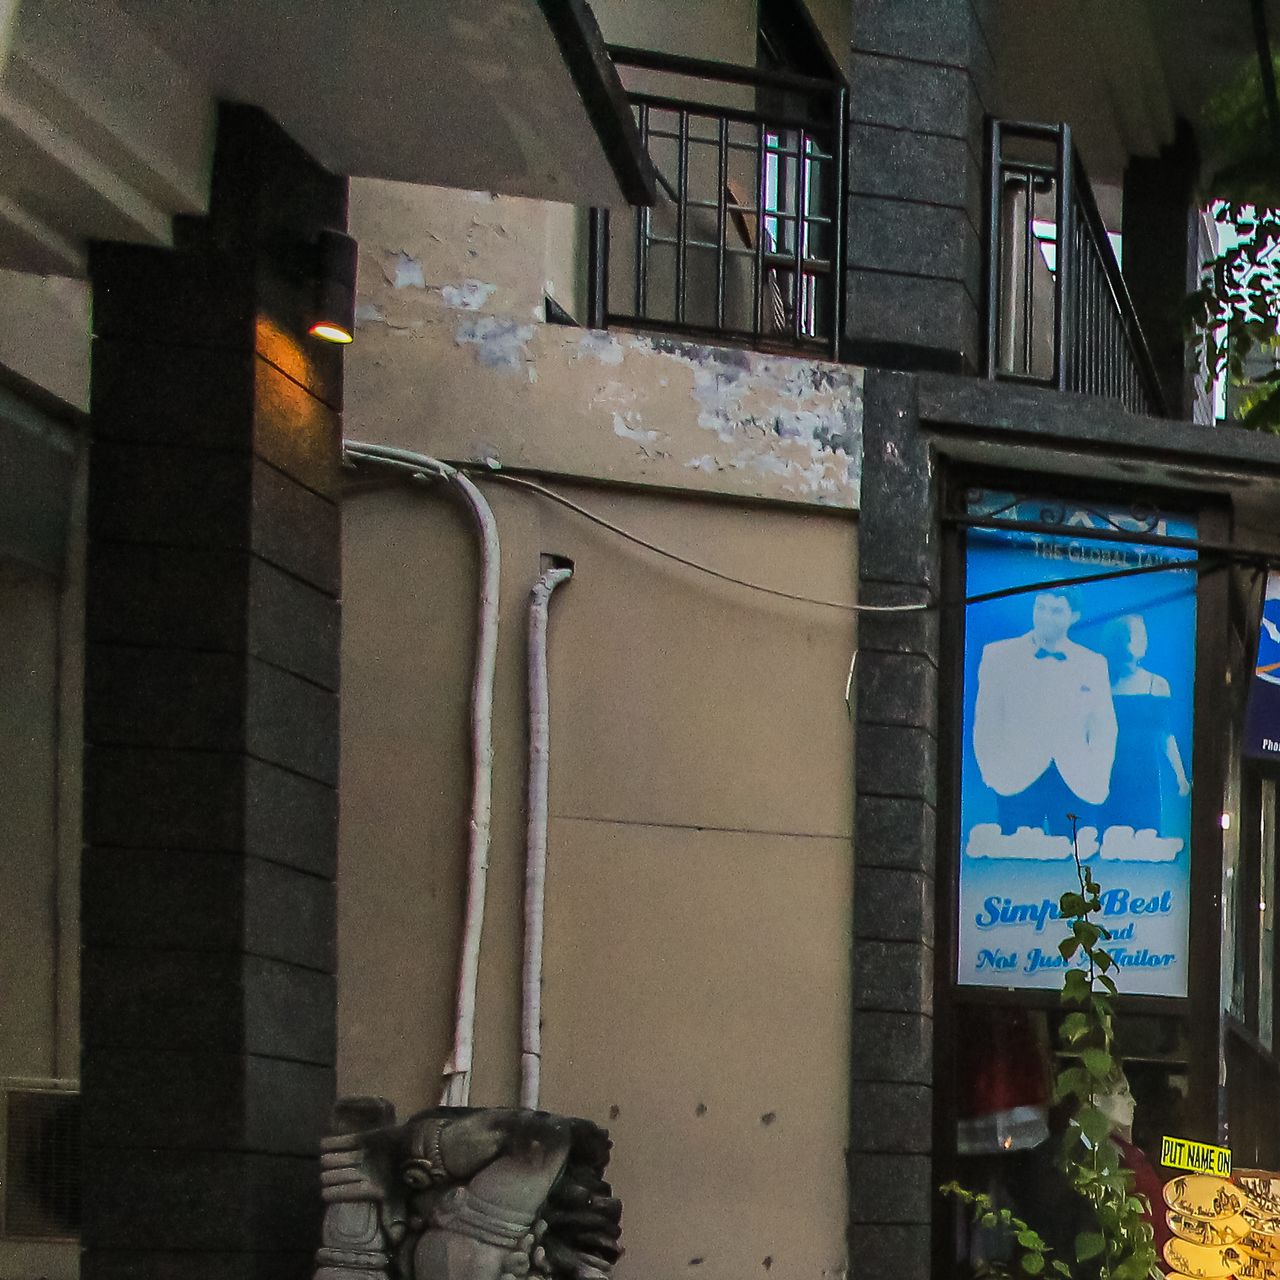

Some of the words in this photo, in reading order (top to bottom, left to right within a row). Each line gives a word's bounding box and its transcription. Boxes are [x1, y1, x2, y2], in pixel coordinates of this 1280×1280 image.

[975, 896, 1076, 932] Simp
[1101, 888, 1173, 916] Best
[975, 949, 1018, 970] Not
[1163, 1139, 1185, 1166] PUT
[1186, 1145, 1215, 1171] NAME
[1217, 1151, 1231, 1174] ON
